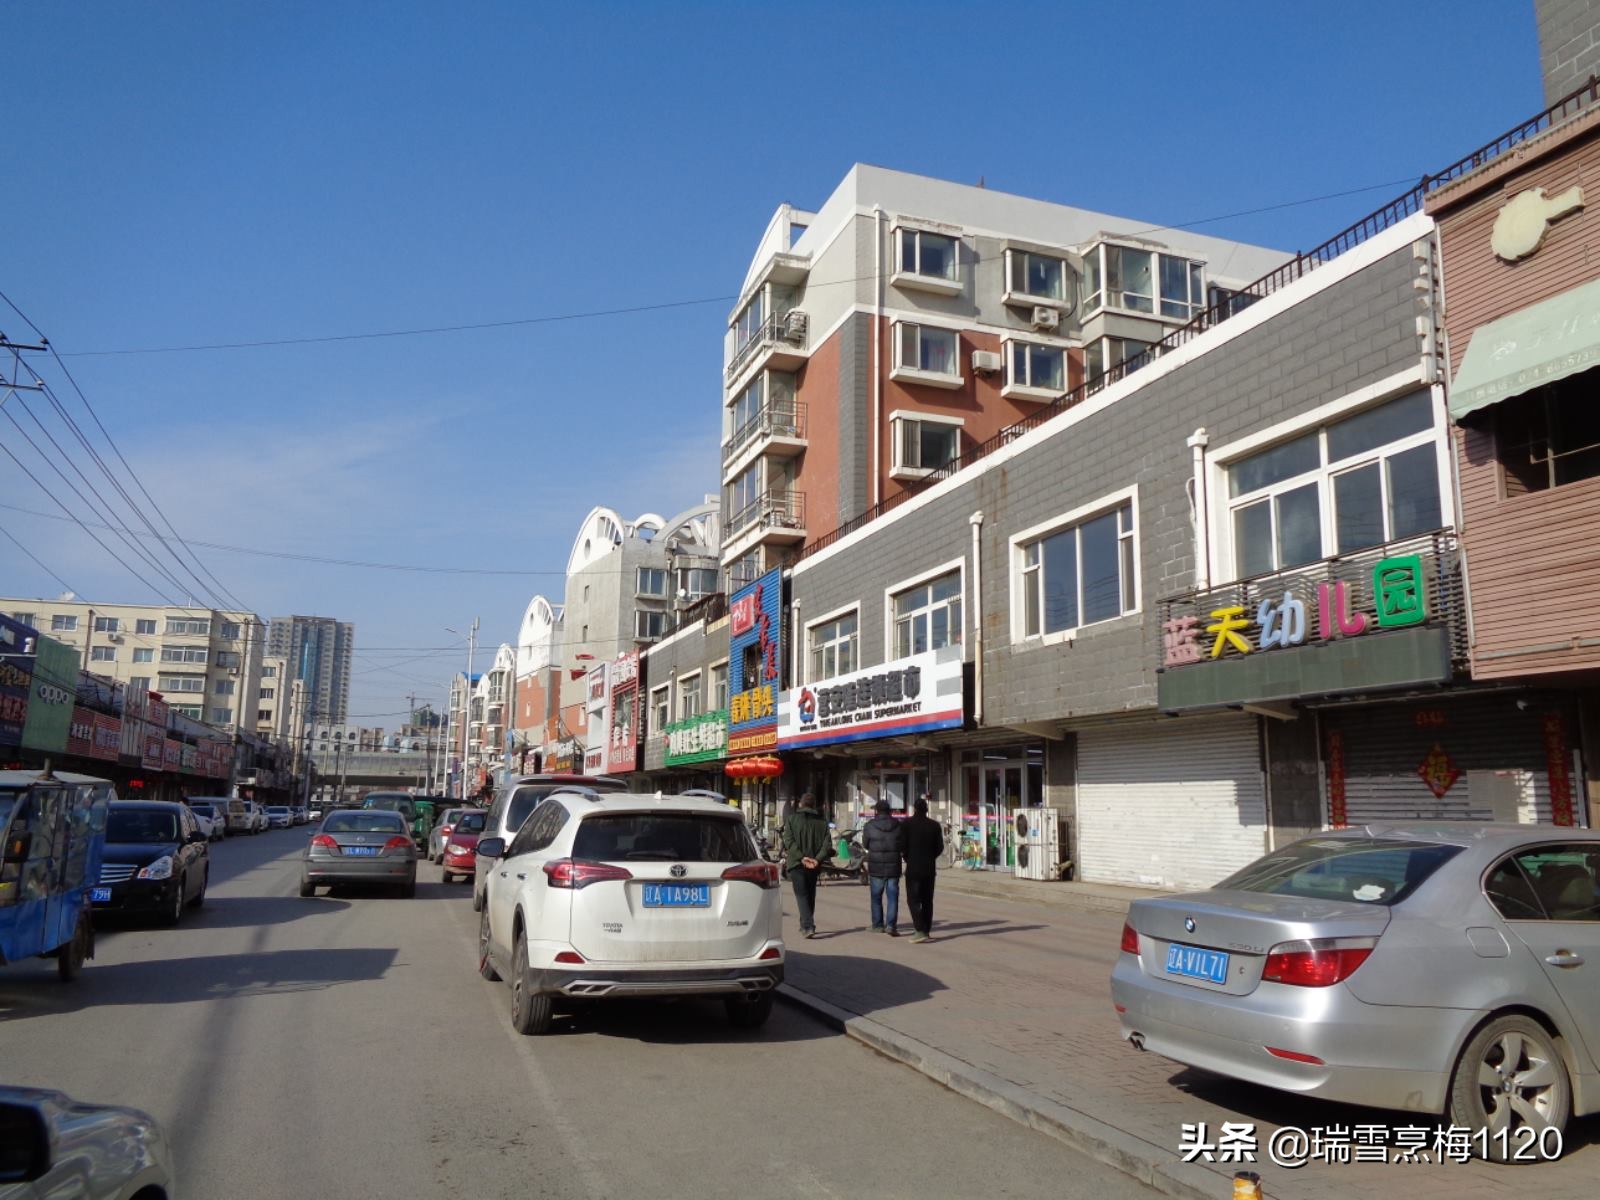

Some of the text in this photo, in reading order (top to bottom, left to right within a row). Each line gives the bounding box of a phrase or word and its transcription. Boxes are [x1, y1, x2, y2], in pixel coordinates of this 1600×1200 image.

[1163, 554, 1426, 666] 蓝天幼儿园
[874, 701, 921, 719] SUPERMARKET
